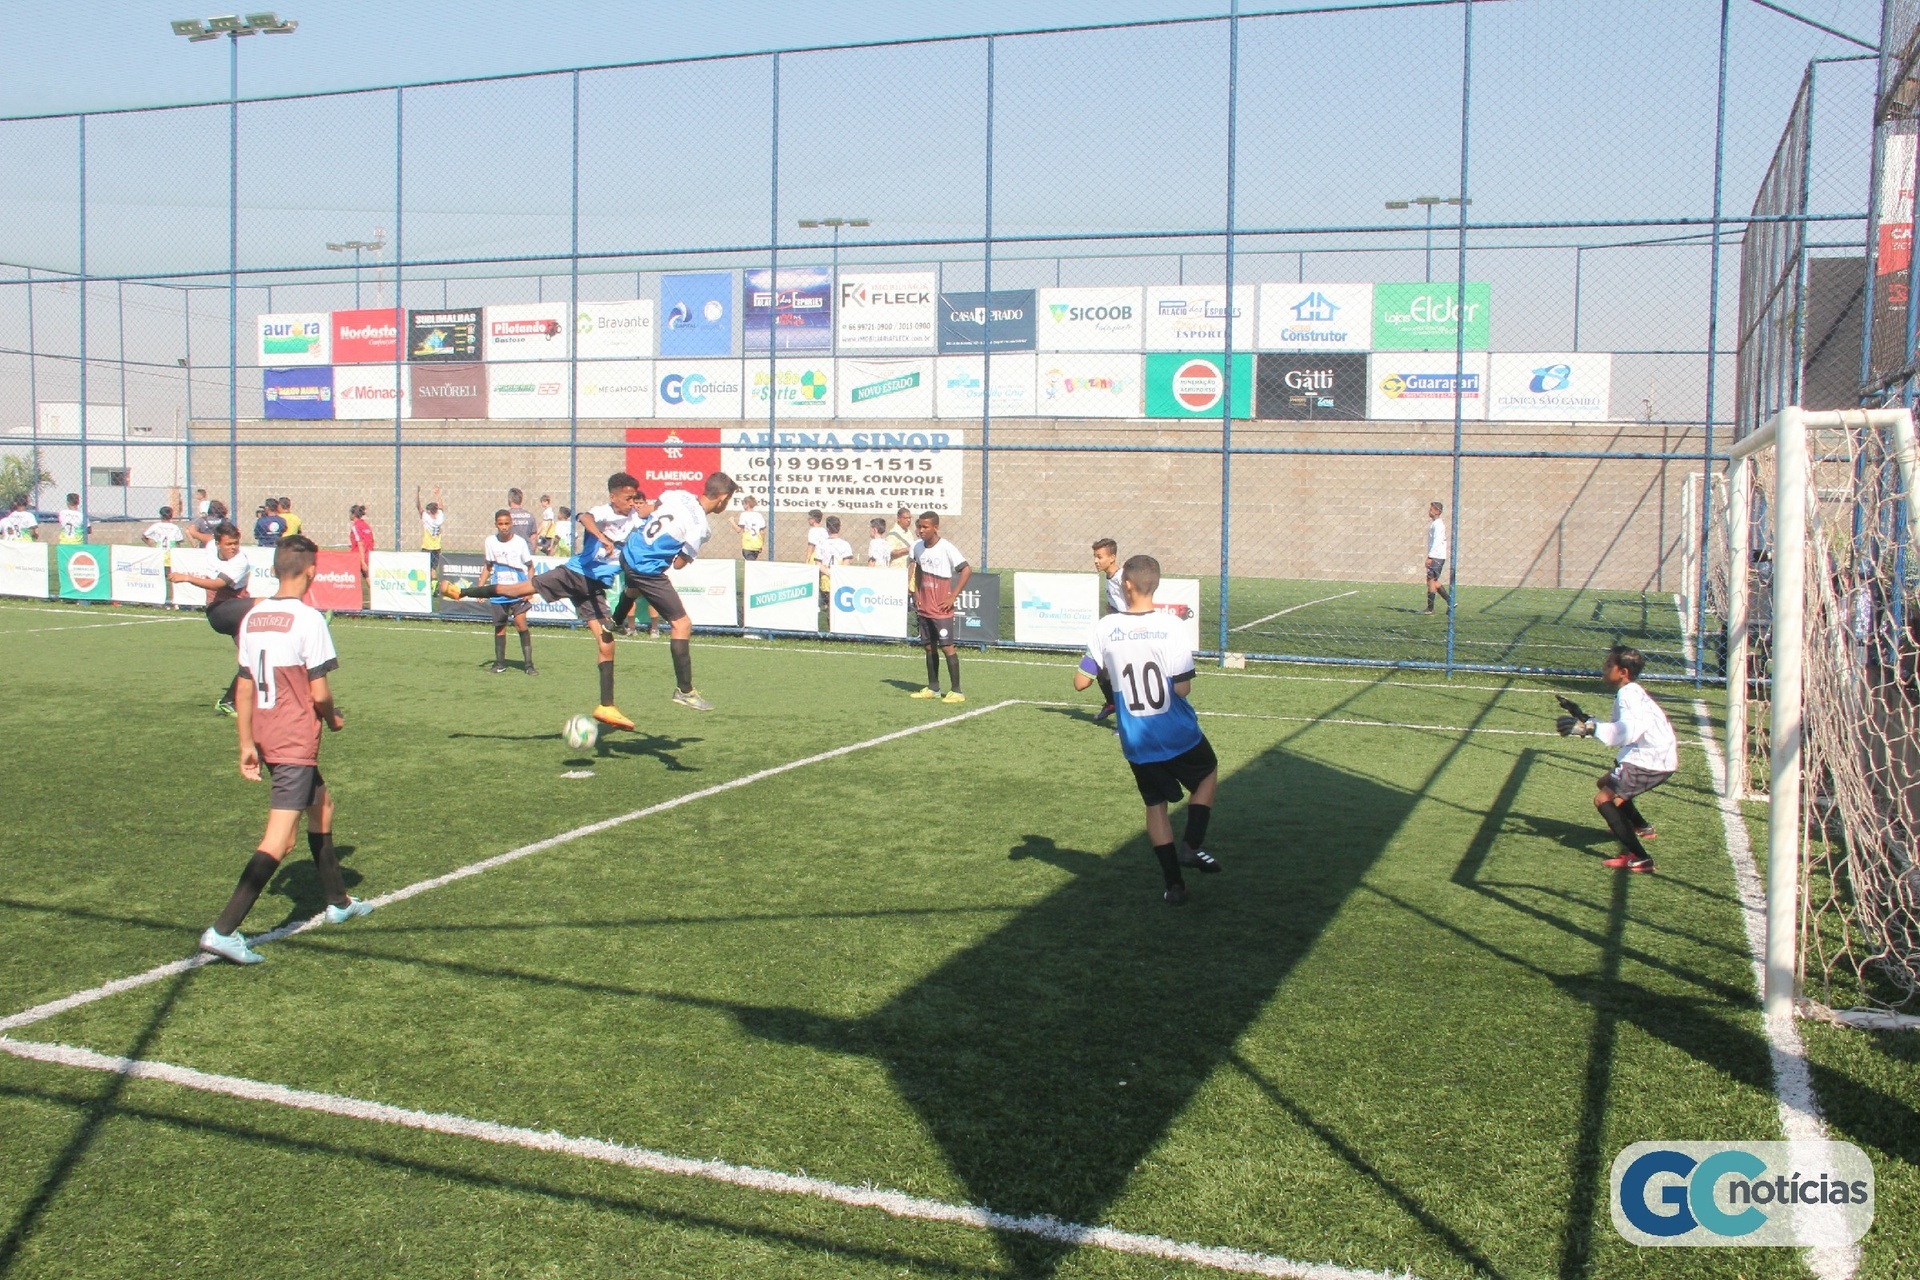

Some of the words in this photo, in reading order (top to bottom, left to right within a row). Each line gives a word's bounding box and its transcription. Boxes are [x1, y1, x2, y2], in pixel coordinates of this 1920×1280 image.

[872, 292, 931, 305] FLECK
[951, 311, 974, 322] CASA
[1069, 306, 1132, 321] SICOOB
[1205, 301, 1241, 318] ESPOES
[1384, 311, 1411, 325] Lojas
[1410, 296, 1479, 323] Elder
[494, 321, 546, 335] Pilotando
[598, 316, 650, 329] Bravante
[1281, 328, 1348, 342] Construtor
[753, 370, 800, 385] Notão
[1406, 375, 1478, 392] Guarapari
[598, 385, 648, 393] MEGAMODAS
[660, 373, 707, 405] GC
[694, 382, 738, 394] notícias
[857, 386, 881, 400] NOVO
[883, 377, 913, 393] ESTADO
[1538, 395, 1559, 405] SÃO
[733, 432, 843, 452] ARENA
[852, 432, 950, 453] SINOP
[788, 457, 801, 470] 9
[806, 457, 932, 471] 9691-1515
[645, 470, 703, 481] FLAMENGO
[735, 473, 782, 482] ESCAE
[787, 474, 813, 482] SEU
[818, 474, 858, 484] TIME,
[863, 475, 944, 484] CONVOQUE
[735, 486, 745, 494] A
[814, 486, 822, 494] E
[827, 487, 875, 496] VENHA
[880, 488, 934, 496] CURTIR
[783, 498, 828, 508] Society
[837, 500, 883, 510] Squash
[897, 501, 949, 510] Eventos
[65, 522, 73, 536] 7
[646, 514, 675, 539] 6
[443, 565, 484, 575] SUBLIMAL
[314, 572, 355, 583] ordeste
[380, 579, 406, 591] Sorte
[755, 594, 777, 606] NOVO
[778, 587, 807, 601] ESTADO
[834, 586, 875, 614] GC
[864, 595, 904, 607] notícias
[953, 590, 981, 610] atti
[530, 601, 568, 613] nstrutor
[1039, 610, 1071, 619] Oswaldo
[1073, 612, 1092, 620] Cruz
[1128, 630, 1168, 640] Construtor
[257, 649, 269, 703] 4
[1122, 661, 1166, 711] 10
